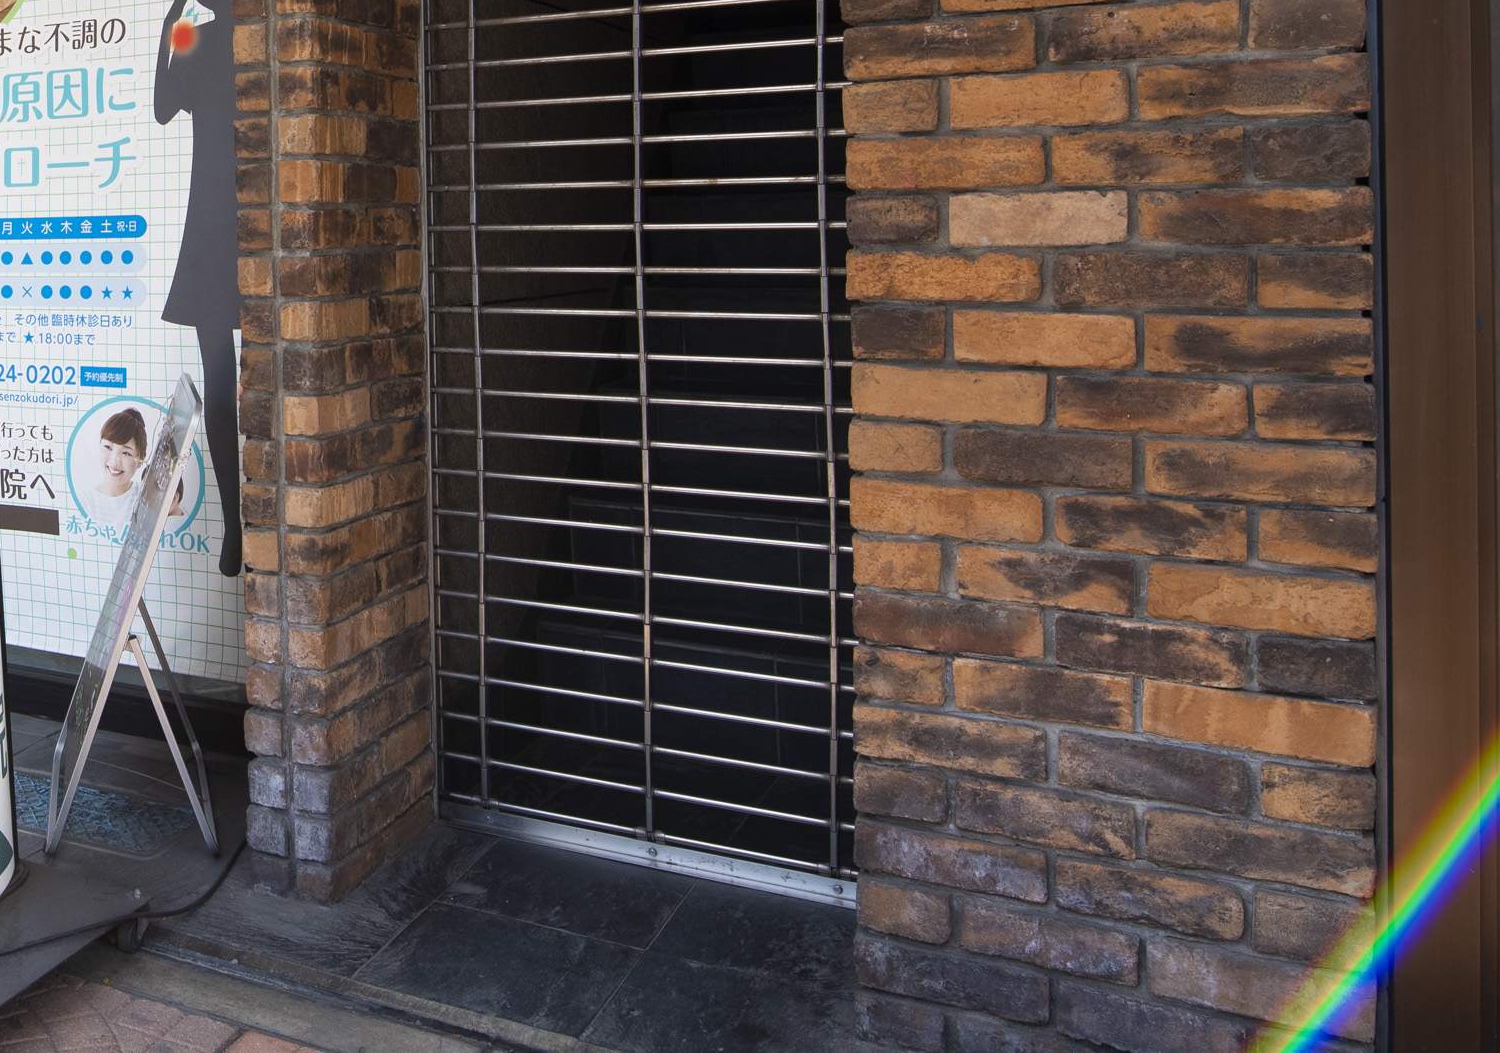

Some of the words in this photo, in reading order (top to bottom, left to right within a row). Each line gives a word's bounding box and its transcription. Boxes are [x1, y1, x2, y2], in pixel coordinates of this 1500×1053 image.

[1, 222, 13, 235] 月
[21, 221, 33, 235] 火
[41, 221, 53, 234] 水
[60, 220, 73, 234] 木
[80, 220, 93, 234] 金
[101, 220, 113, 233] 土
[52, 313, 133, 328] 臨時休診日あり
[84, 372, 123, 383] 予約優先制
